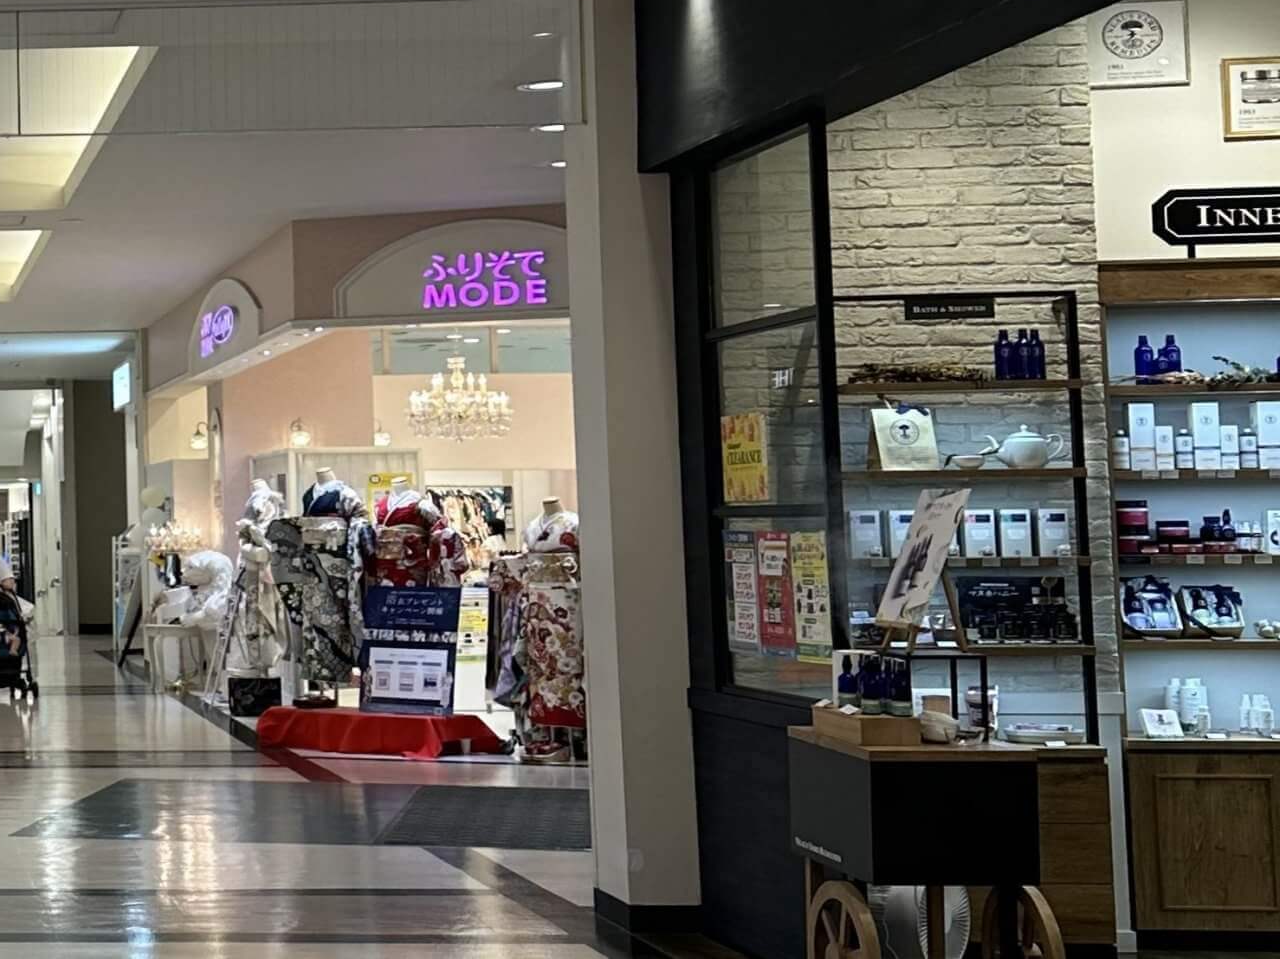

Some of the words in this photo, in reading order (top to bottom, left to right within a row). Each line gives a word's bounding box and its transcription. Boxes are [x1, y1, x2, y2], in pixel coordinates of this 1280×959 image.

[423, 251, 545, 281] ふりそで
[423, 279, 547, 309] MODE
